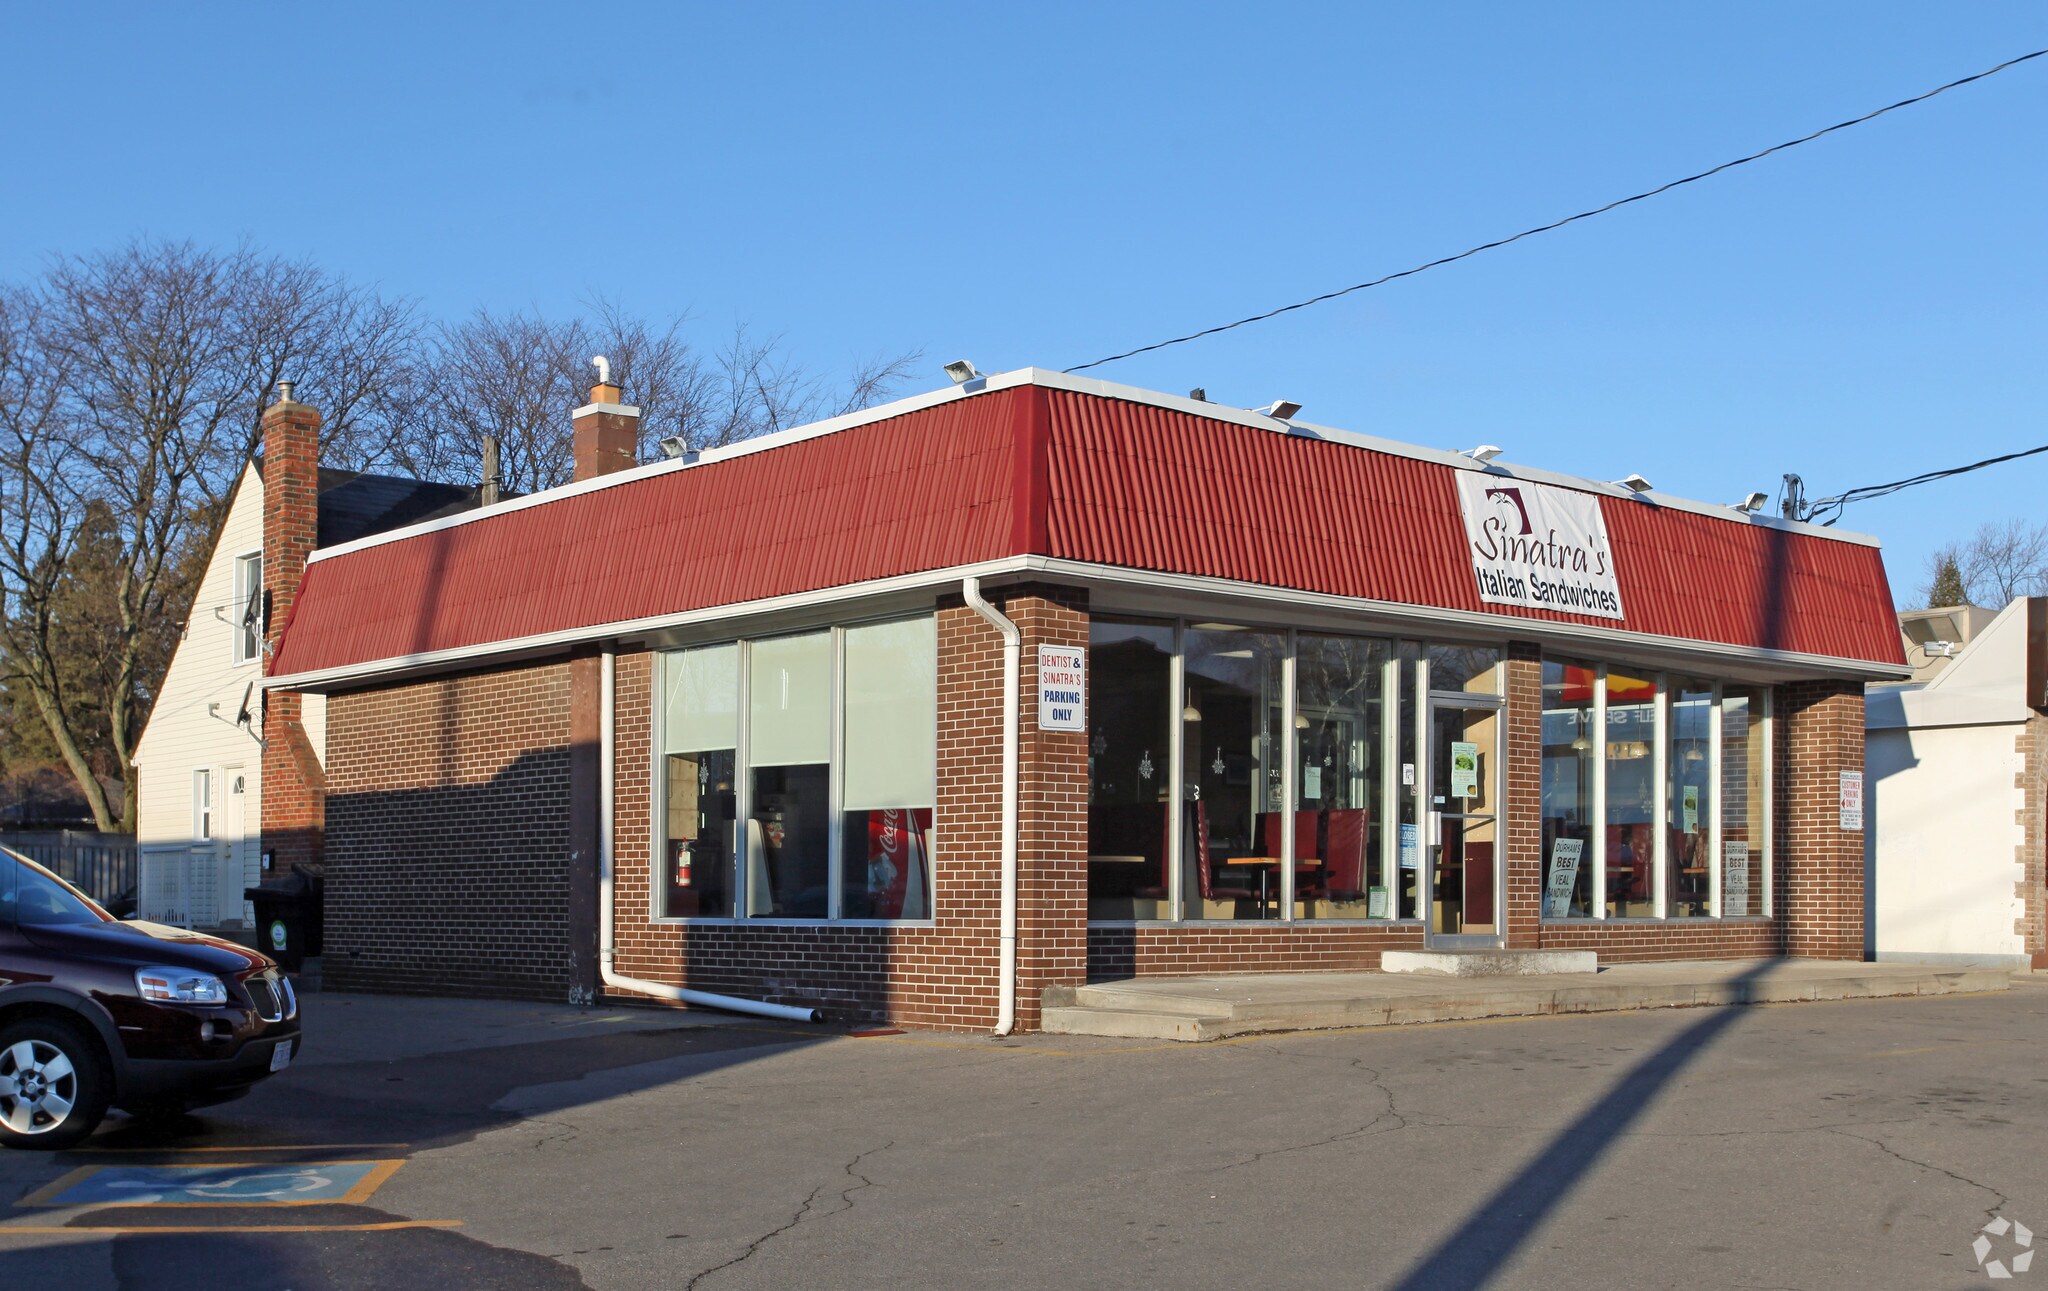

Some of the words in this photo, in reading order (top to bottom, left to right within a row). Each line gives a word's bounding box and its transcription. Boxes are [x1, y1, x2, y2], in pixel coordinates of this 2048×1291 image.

[1474, 516, 1605, 576] Sinatra's
[1476, 566, 1527, 599] Italian
[1529, 572, 1618, 612] Sandwiches
[1042, 655, 1071, 668] DENTIST
[1073, 657, 1081, 669] &
[1043, 671, 1081, 686] SINATRA'S
[1044, 689, 1080, 704] PARKING
[1052, 708, 1072, 721] ONLY
[1842, 781, 1860, 789] CUSTOMER
[1844, 790, 1858, 798] PARKING
[1400, 831, 1416, 840] LOSED
[1556, 856, 1576, 868] BEST
[1729, 857, 1745, 868] BEST
[1555, 874, 1570, 886] VEAL
